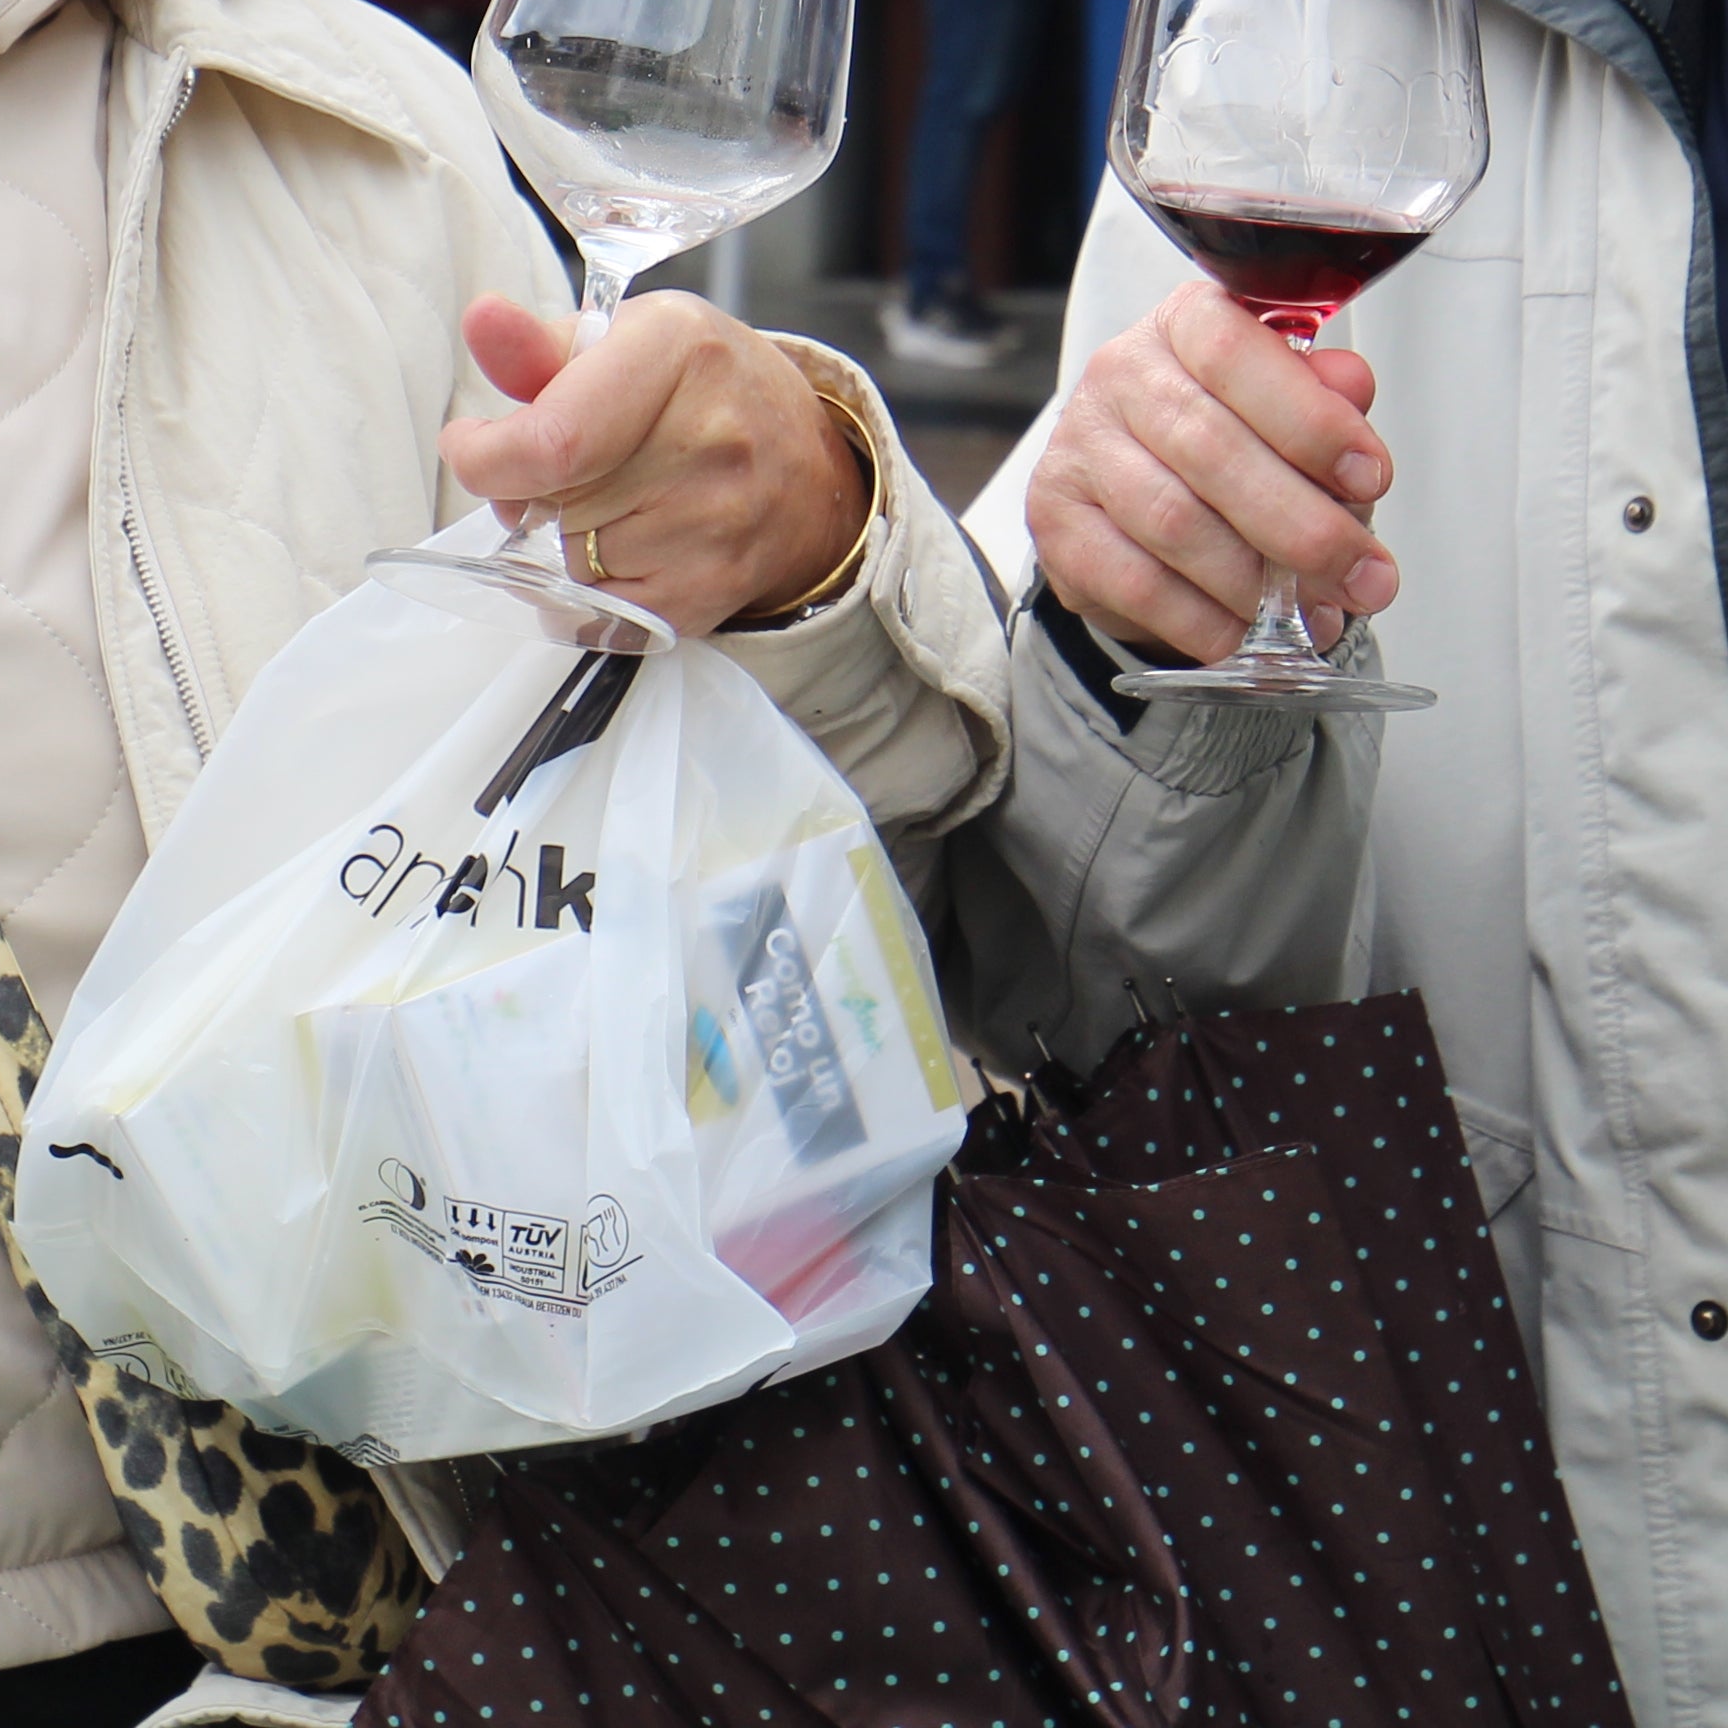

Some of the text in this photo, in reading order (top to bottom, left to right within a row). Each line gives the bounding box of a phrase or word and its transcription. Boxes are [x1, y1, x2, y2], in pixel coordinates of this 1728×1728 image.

[764, 927, 843, 1108] Como un
[508, 1245, 556, 1261] AUSTRIA
[509, 1263, 557, 1280] INDUSTRIAL
